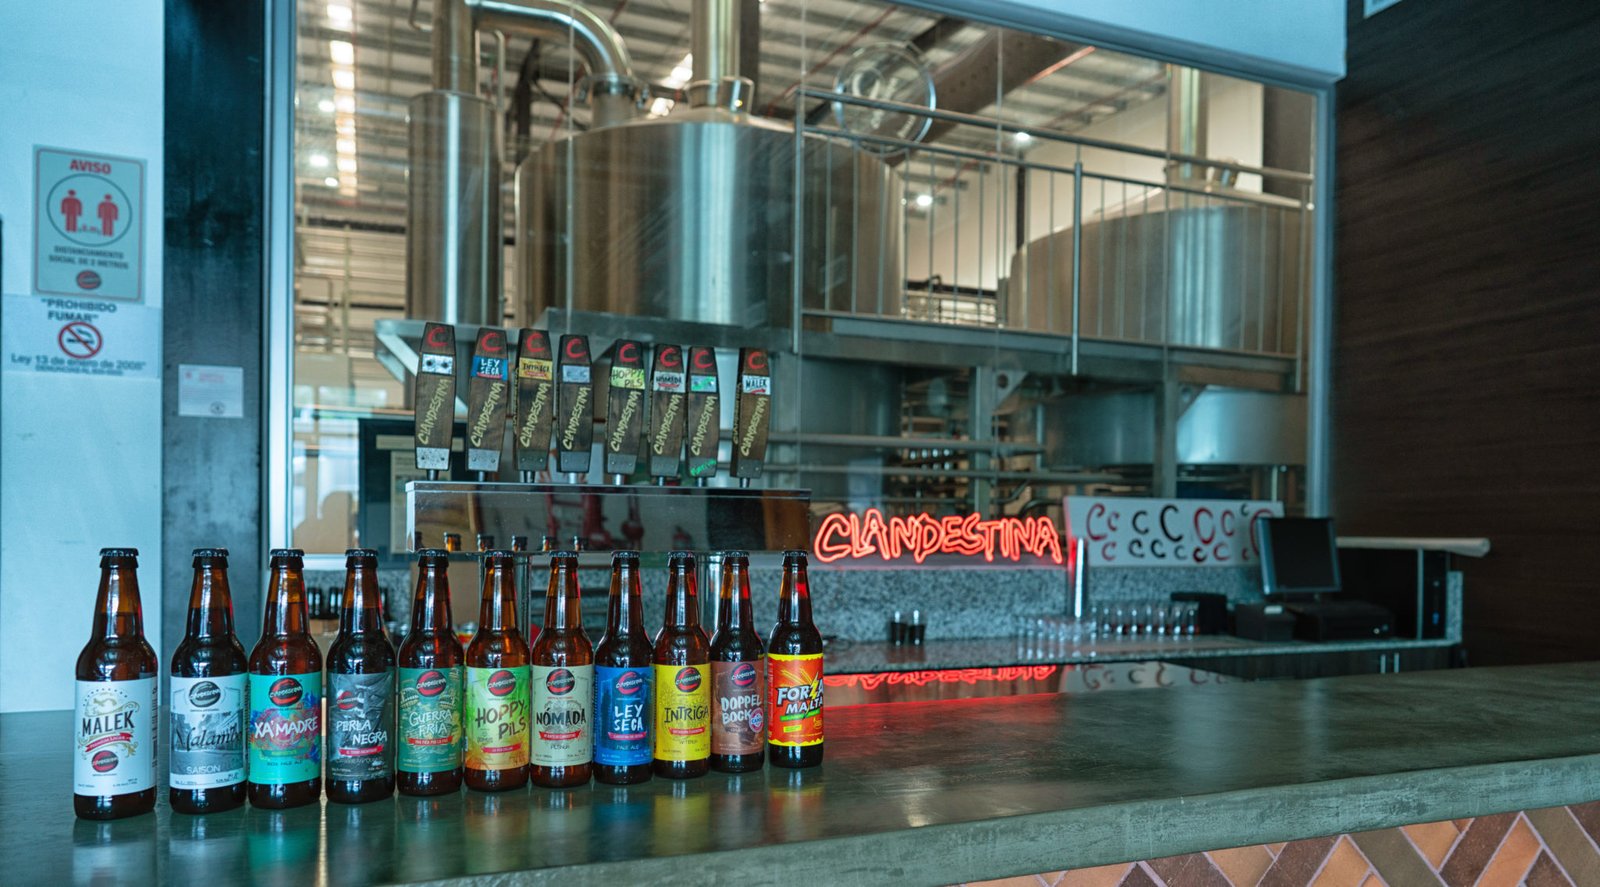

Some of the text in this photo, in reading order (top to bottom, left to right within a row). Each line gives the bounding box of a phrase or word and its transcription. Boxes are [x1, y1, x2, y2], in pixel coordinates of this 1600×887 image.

[69, 159, 111, 175] AVISO
[427, 327, 448, 347] C
[481, 332, 502, 353] C
[526, 332, 545, 353] C
[566, 338, 587, 358] C
[619, 343, 638, 363] C
[660, 348, 680, 367] C
[11, 353, 32, 366] Ley
[36, 355, 48, 364] 13
[50, 356, 65, 365] de
[67, 358, 98, 368] enero
[100, 359, 114, 369] de
[481, 358, 500, 367] LEY
[694, 350, 714, 369] C
[748, 351, 767, 370] C
[480, 366, 500, 375] SECA
[612, 368, 644, 380] HOPPY
[746, 379, 767, 389] MALEK
[418, 378, 452, 445] CLANDESTINA
[471, 382, 505, 447] CLANDESTINA
[520, 382, 551, 448] CLANDESTINA
[562, 386, 591, 450] CLANDESTINA
[610, 390, 642, 452] CLANDESTINA
[654, 394, 683, 455] CLANDESTINA
[691, 395, 718, 456] CLANDESTINA
[741, 396, 769, 457] CLANDESTINA
[1160, 504, 1184, 542] C
[814, 508, 1063, 565] CLANDESTINA
[777, 673, 824, 707] FORZA
[614, 704, 643, 719] LEY
[721, 694, 762, 712] DOPPEL
[409, 709, 452, 726] GUERRA
[475, 699, 528, 728] HOPPY
[536, 708, 586, 726] NÓMADA
[722, 708, 752, 725] BOCK
[82, 710, 135, 737] MALEK
[336, 719, 371, 732] PERLA
[614, 717, 643, 732] SECA
[352, 730, 388, 745] NEGRA
[186, 764, 221, 774] SAISON
